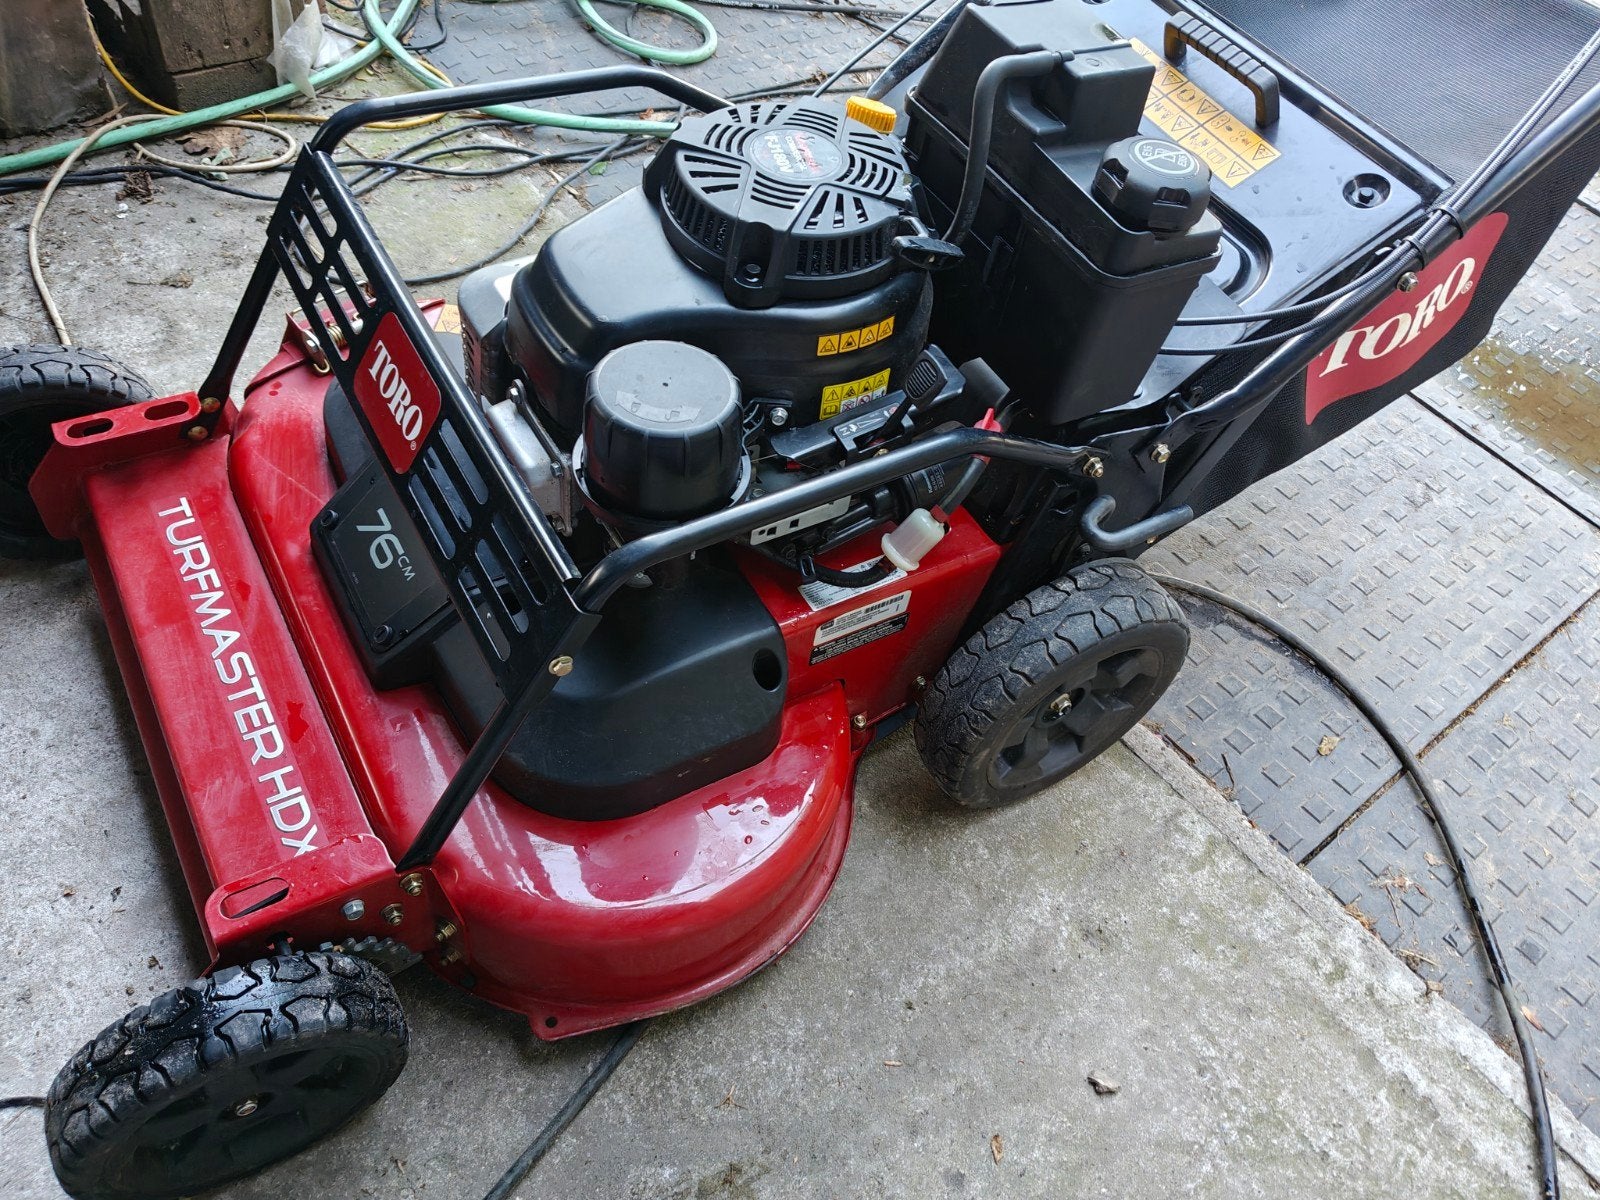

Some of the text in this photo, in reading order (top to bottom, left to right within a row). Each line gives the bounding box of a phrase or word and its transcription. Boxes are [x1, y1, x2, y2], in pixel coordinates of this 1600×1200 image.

[1318, 257, 1475, 378] TORO
[368, 339, 424, 443] TORO
[158, 496, 319, 859] TURFMASTER HDX
